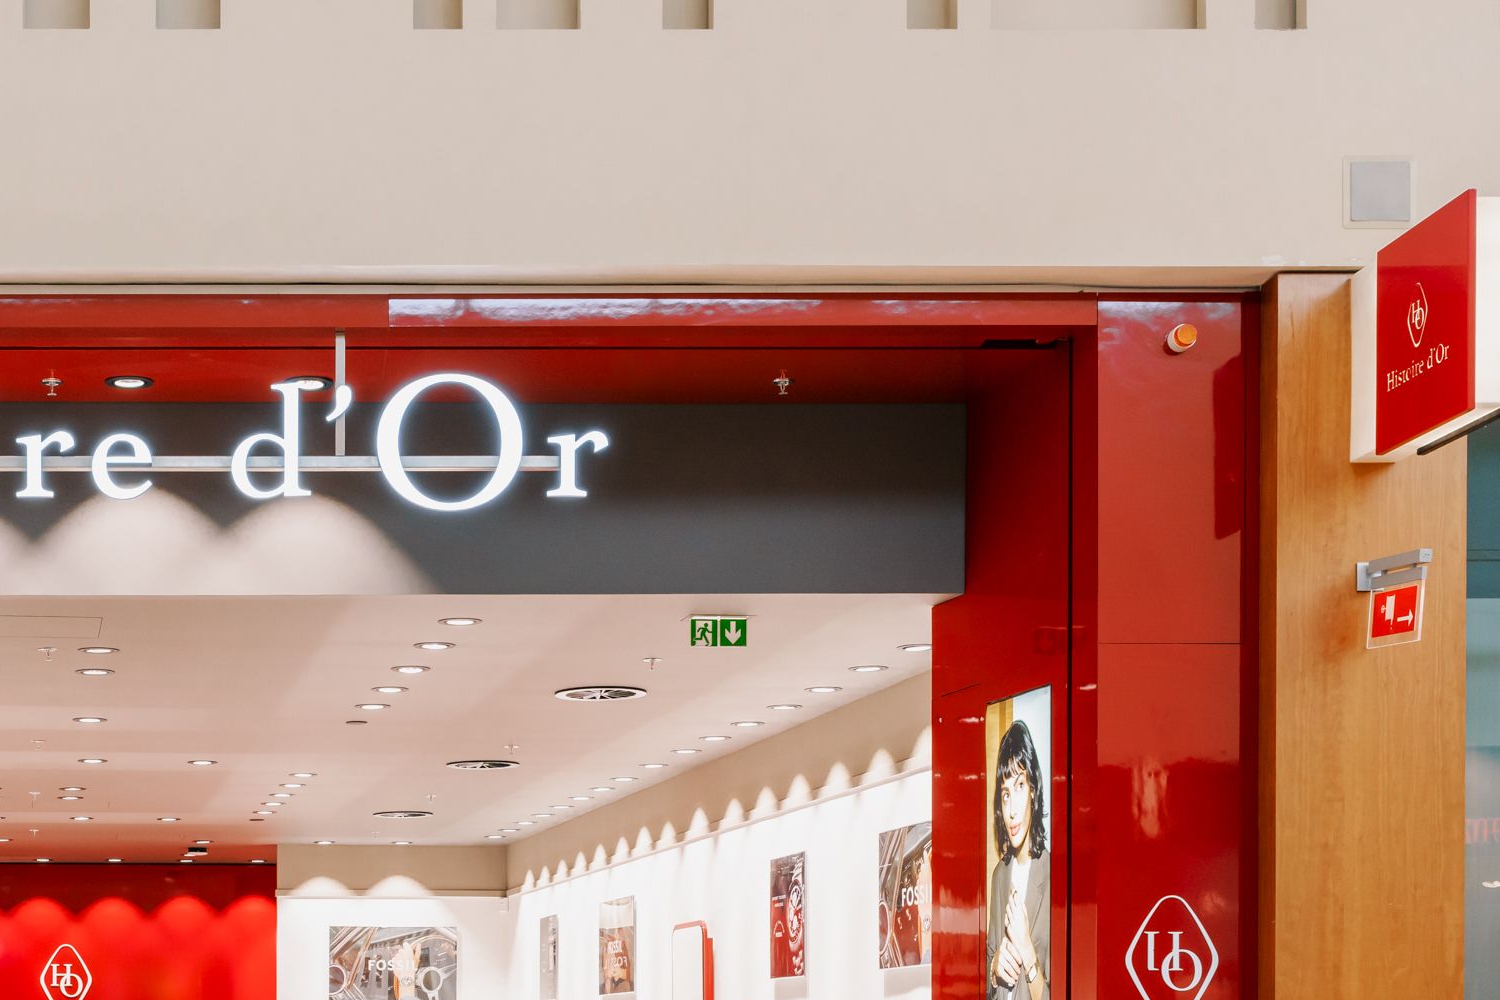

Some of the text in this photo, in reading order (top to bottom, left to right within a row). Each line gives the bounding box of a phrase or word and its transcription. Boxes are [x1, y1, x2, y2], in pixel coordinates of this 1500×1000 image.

[1387, 343, 1450, 392] Histoire d'Or
[231, 373, 609, 511] d'Or
[368, 959, 418, 971] FOSSIL
